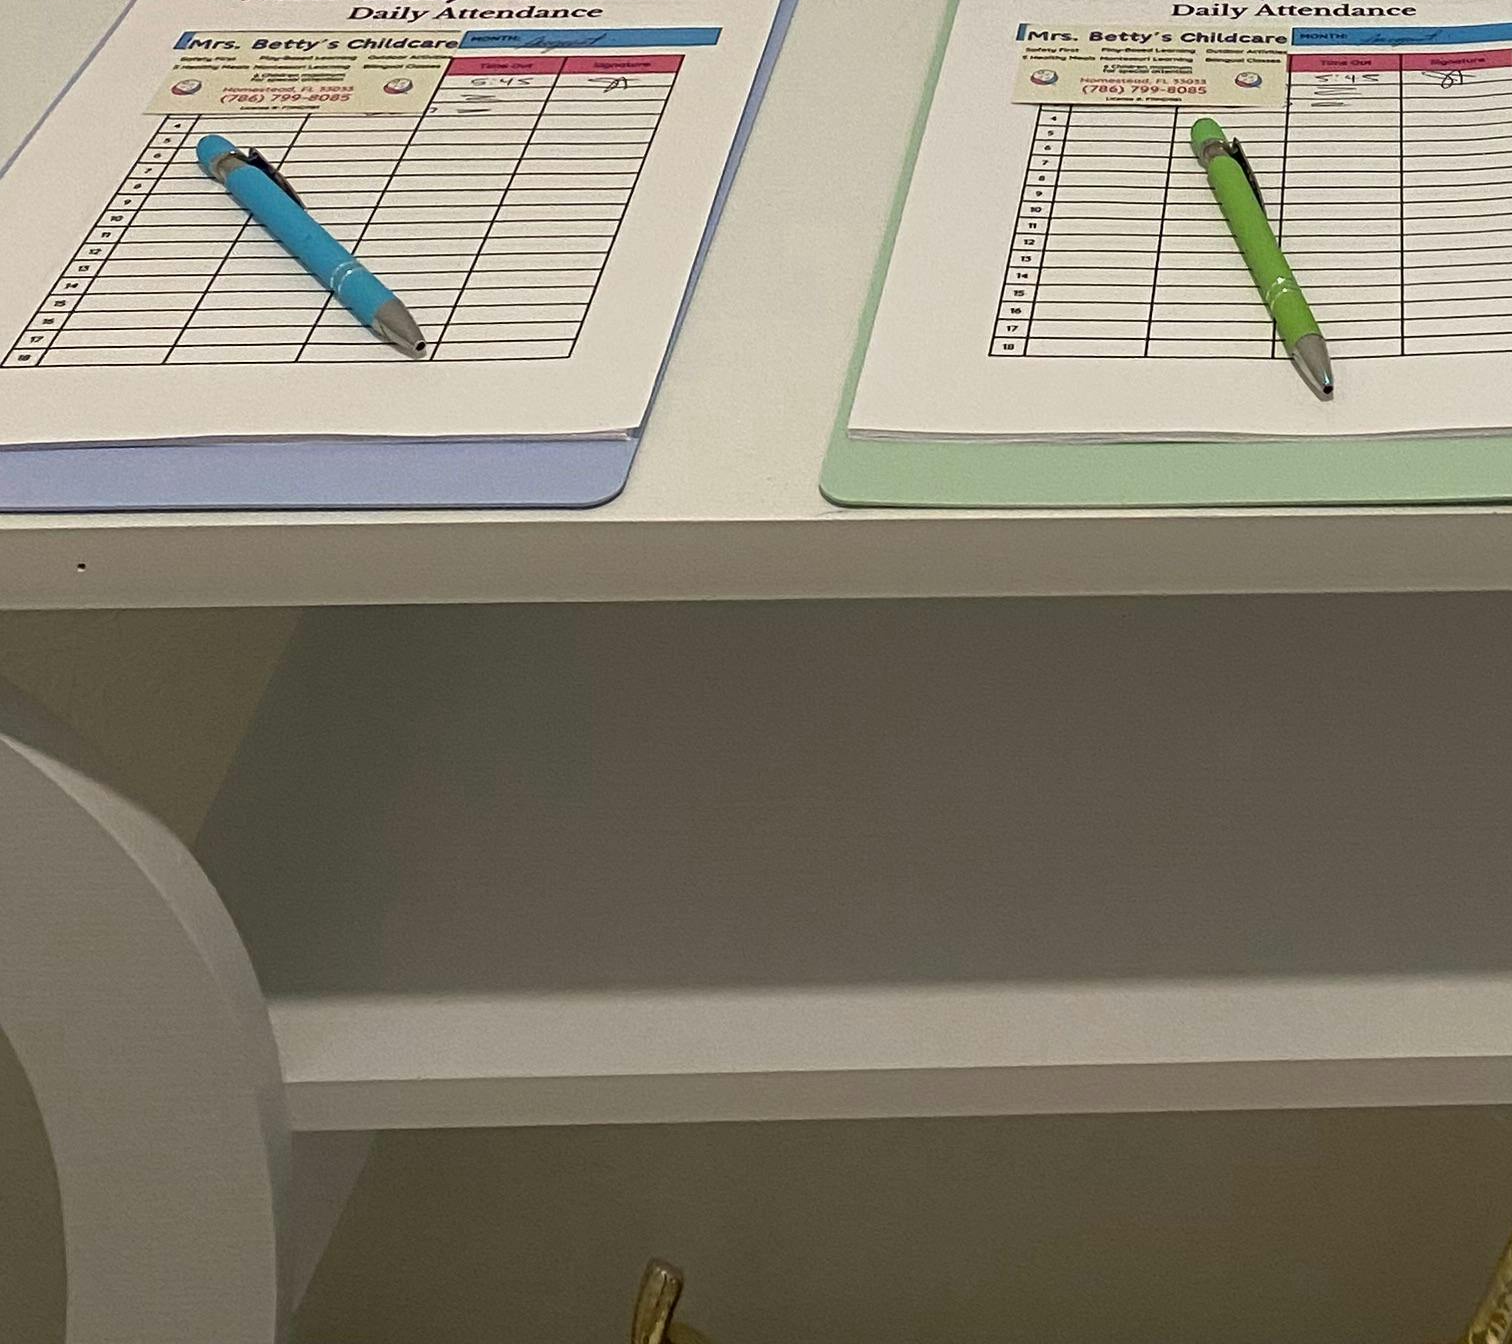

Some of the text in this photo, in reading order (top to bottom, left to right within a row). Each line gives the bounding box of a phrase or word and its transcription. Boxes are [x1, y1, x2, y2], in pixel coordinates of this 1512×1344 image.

[347, 5, 604, 23] Daily Attendance
[1171, 3, 1417, 20] Daily Attendance
[188, 37, 459, 52] Mrs. Betty's Childcare
[1027, 31, 1288, 45] Mrs. Betty's Childcare
[1082, 85, 1208, 95] (786) 799-8085
[220, 94, 265, 104] (786)
